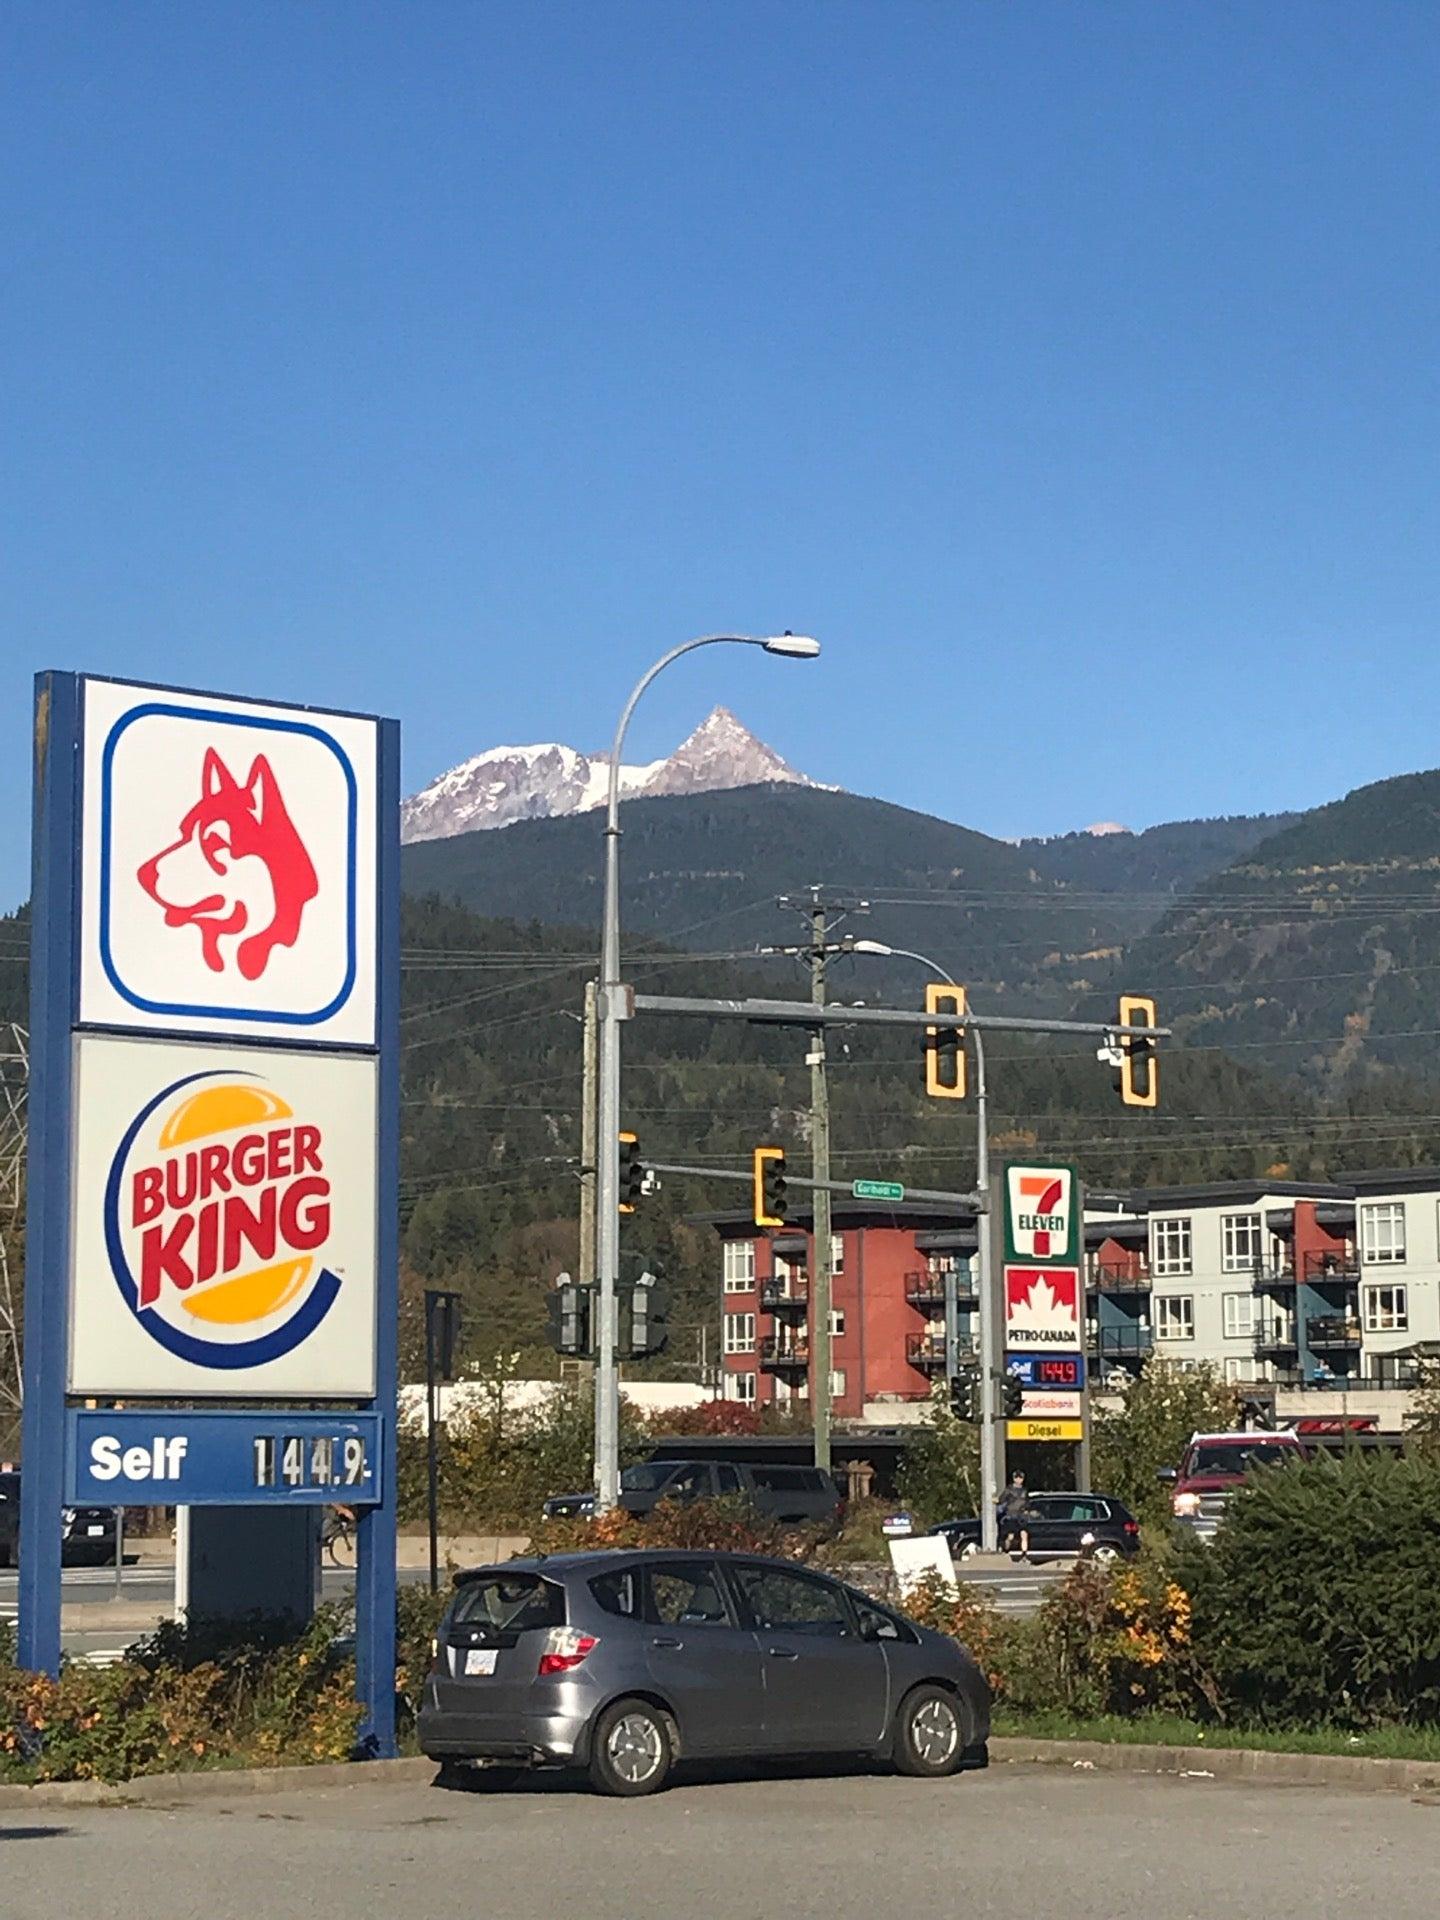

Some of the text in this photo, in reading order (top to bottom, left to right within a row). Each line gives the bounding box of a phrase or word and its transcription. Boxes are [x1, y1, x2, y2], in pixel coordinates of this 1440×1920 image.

[132, 1125, 323, 1229] BURGER
[1020, 1177, 1062, 1255] 7
[141, 1176, 330, 1307] KING
[89, 1435, 363, 1487] Self 144.9
[1027, 1424, 1062, 1436] Diesel
